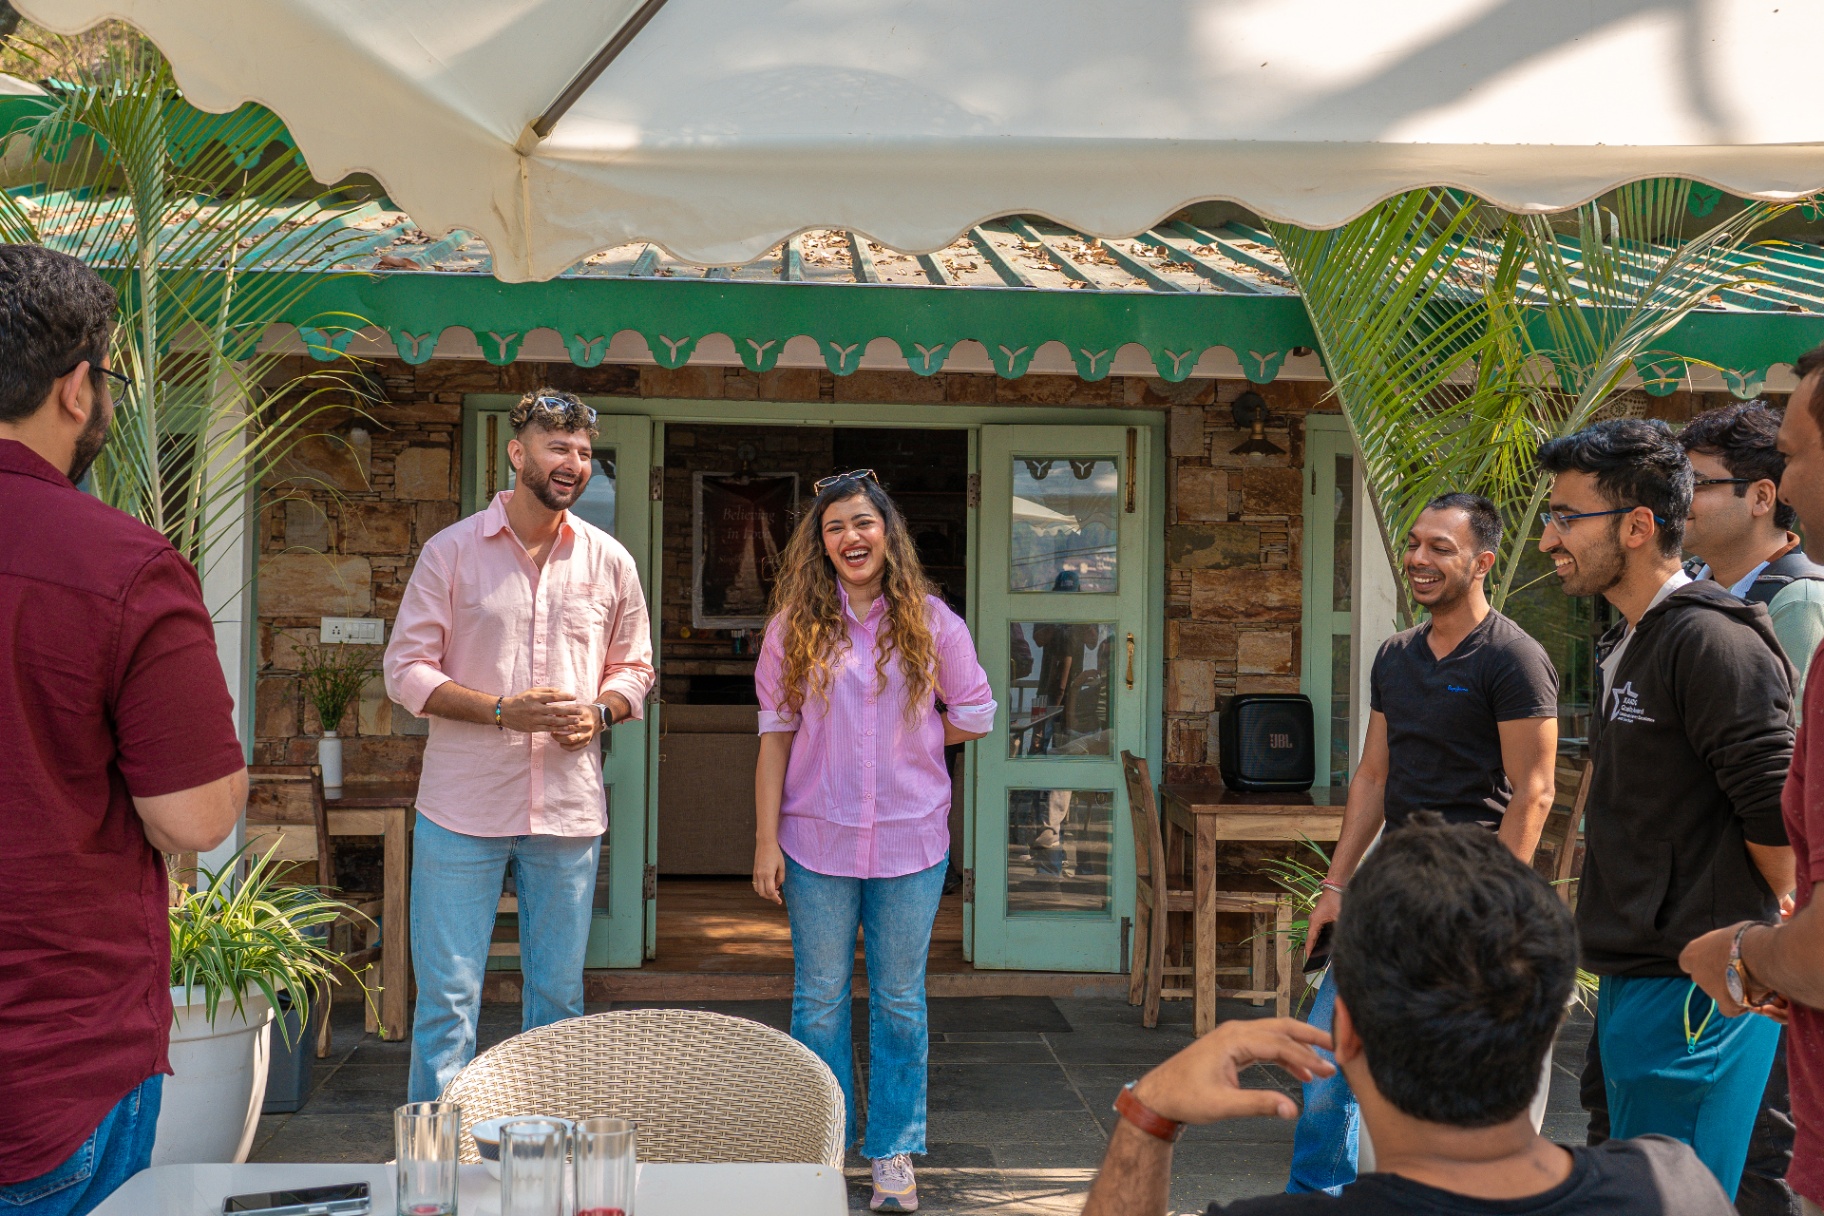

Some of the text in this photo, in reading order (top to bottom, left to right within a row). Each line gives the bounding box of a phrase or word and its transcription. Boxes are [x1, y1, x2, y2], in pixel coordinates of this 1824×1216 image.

[723, 504, 776, 524] Believing
[727, 527, 739, 540] in
[1269, 733, 1293, 749] JBL
